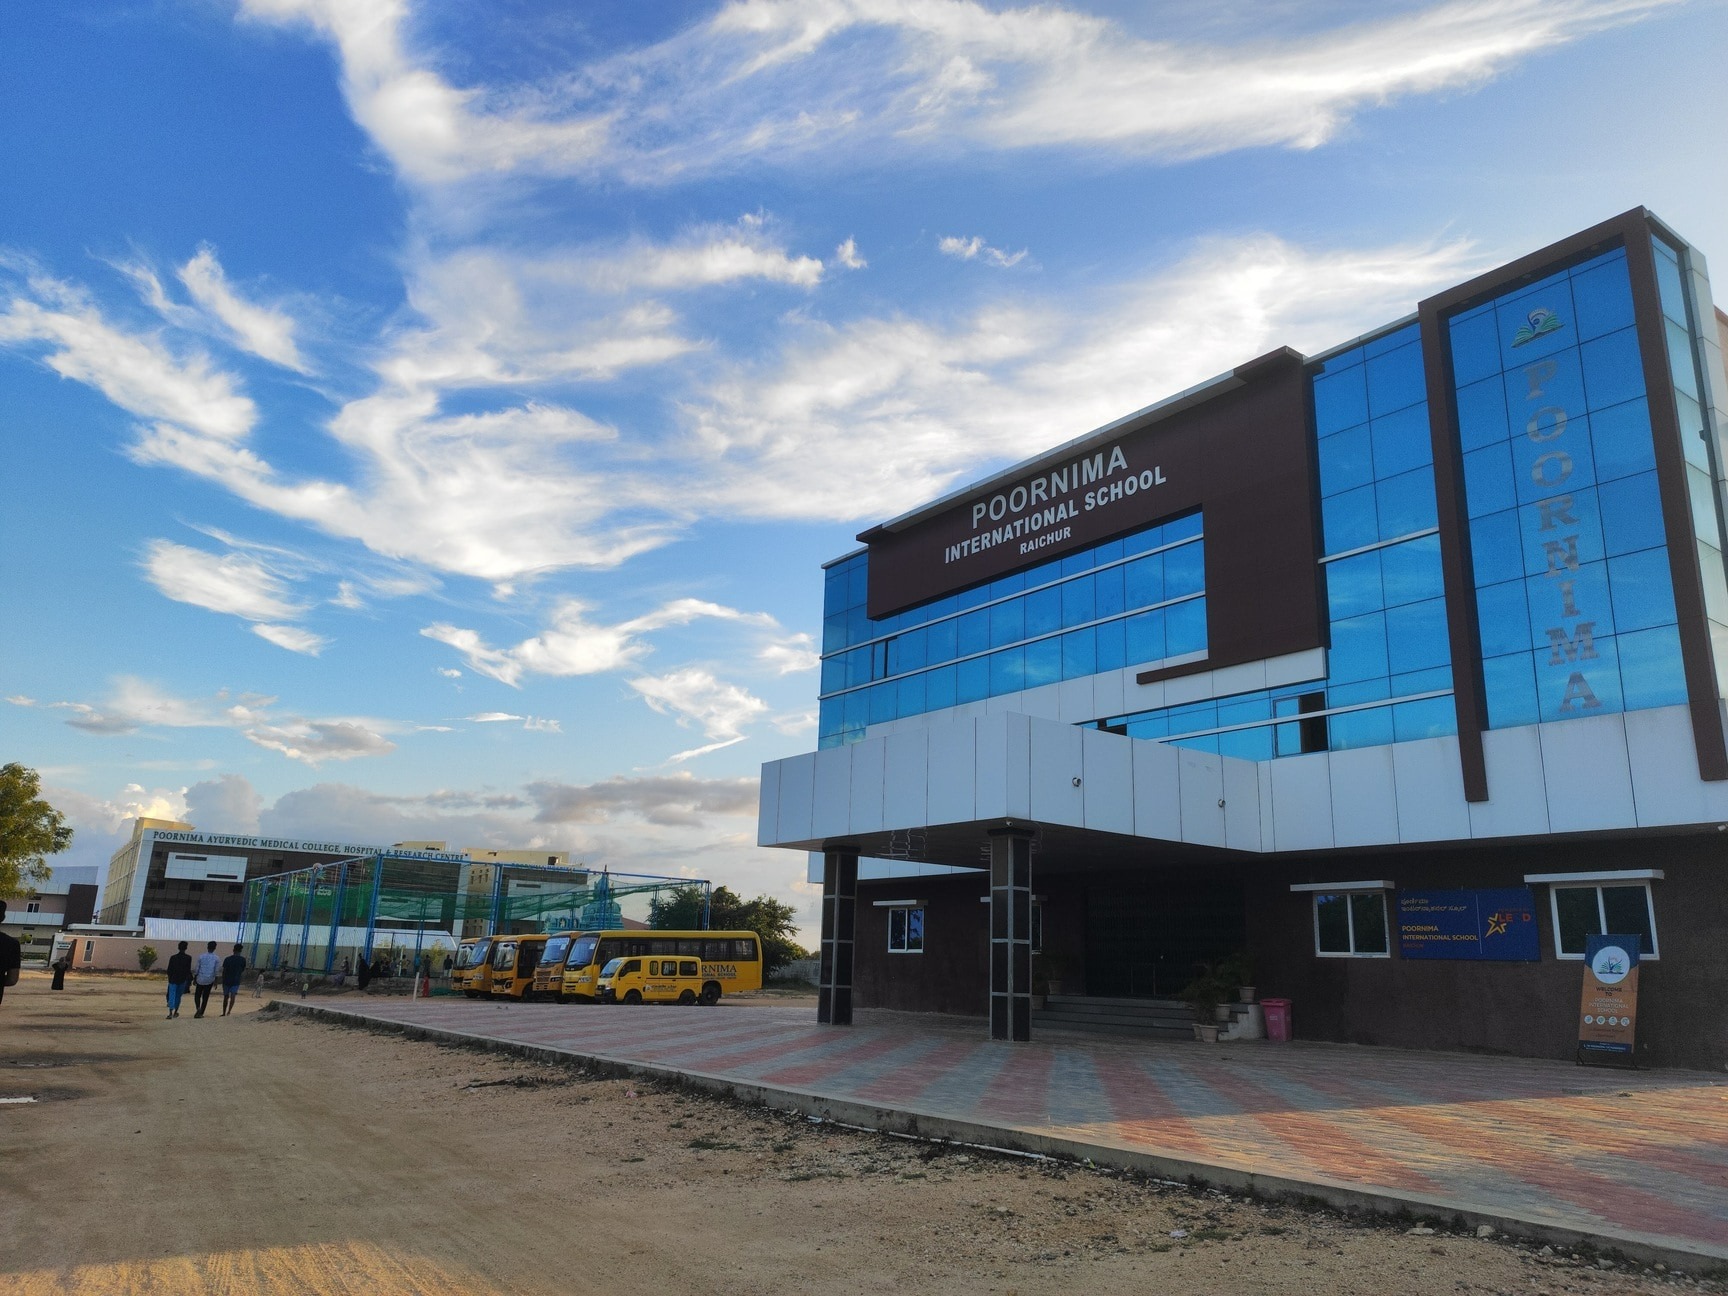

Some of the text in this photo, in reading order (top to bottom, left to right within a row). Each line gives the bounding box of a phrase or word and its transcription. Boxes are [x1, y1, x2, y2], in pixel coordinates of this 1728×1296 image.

[945, 466, 1167, 564] INTERNATIONAL SCHOOL
[972, 445, 1128, 529] POORNIMA
[1019, 526, 1072, 555] RAICHUR
[1523, 360, 1602, 712] POORNIMA
[153, 831, 204, 842] POORNIMA
[207, 835, 258, 847] AYURVEDIC
[260, 839, 299, 850] MEDICAL
[302, 842, 341, 854] COLLEGE,
[344, 845, 382, 856] HOSPITAL
[394, 849, 433, 862] RESEARCH
[435, 853, 464, 862] CENTRE
